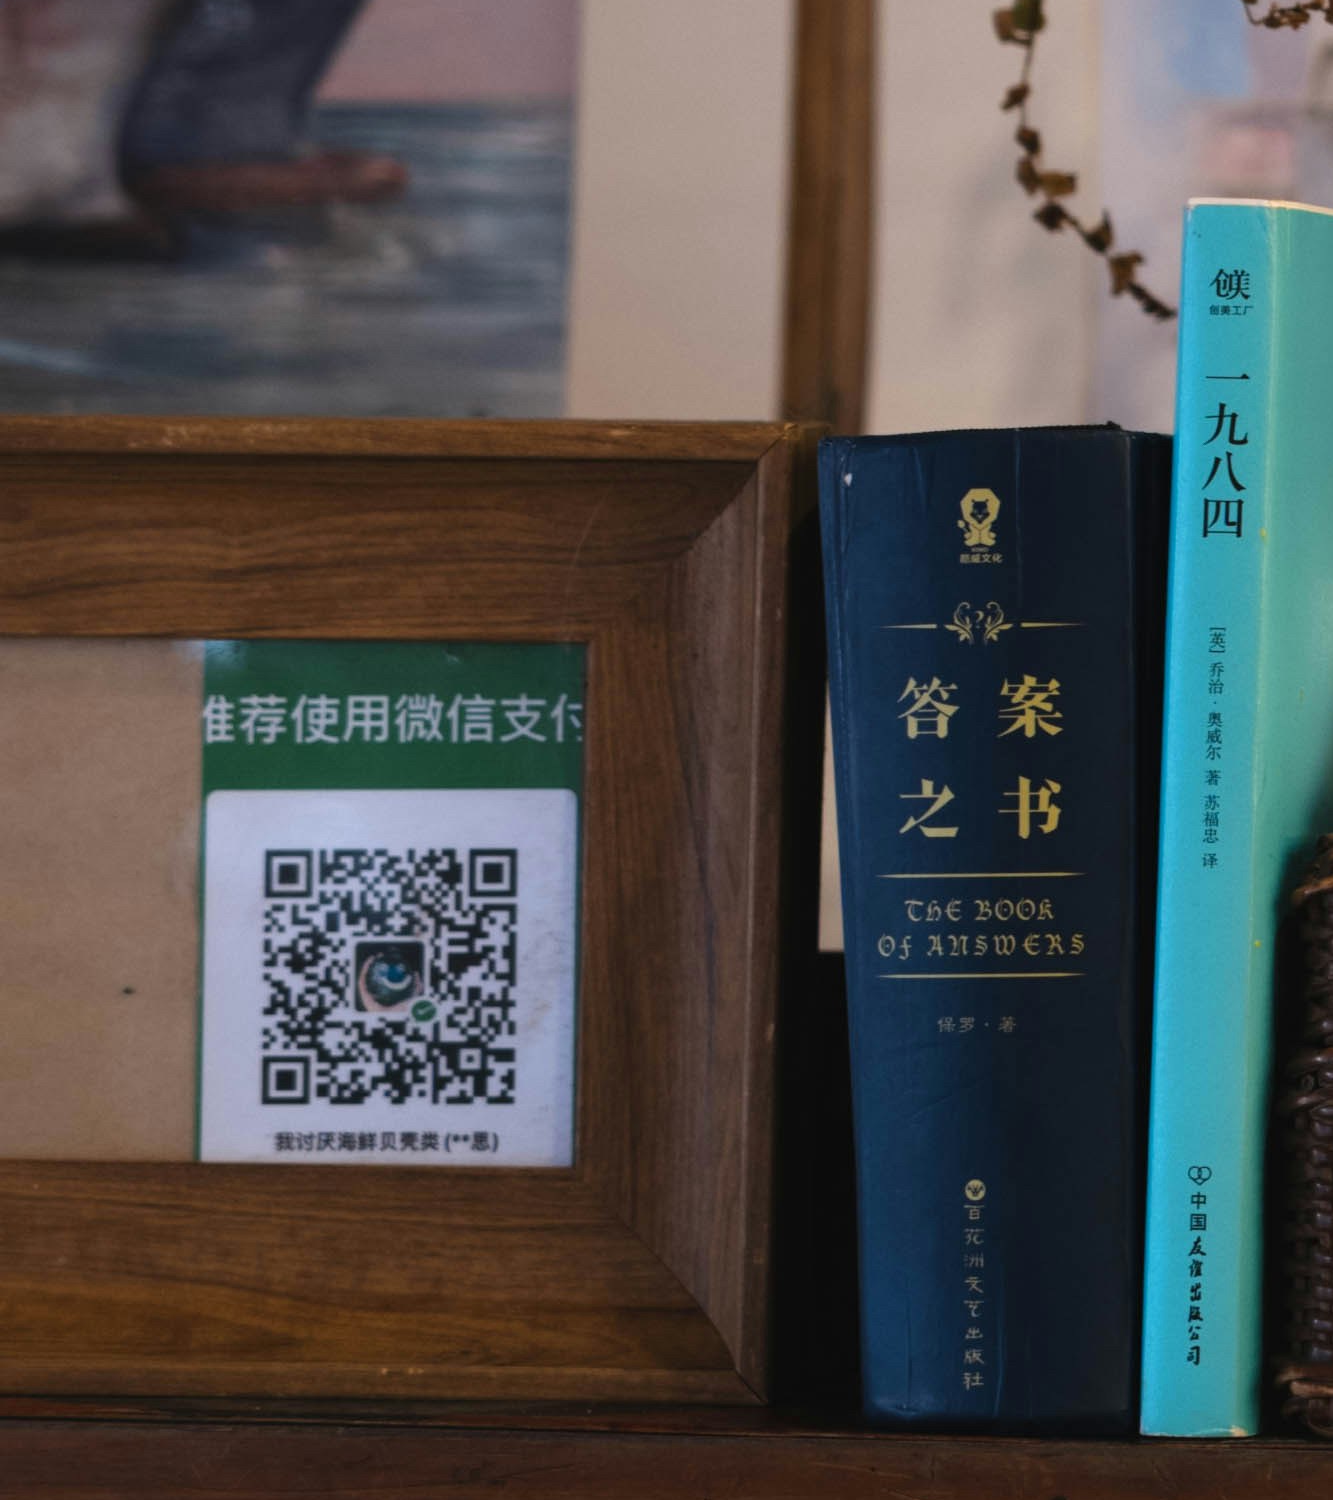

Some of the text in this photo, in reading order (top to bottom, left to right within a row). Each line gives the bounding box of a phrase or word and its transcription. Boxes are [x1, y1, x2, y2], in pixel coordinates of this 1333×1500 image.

[1209, 304, 1254, 316] 创美工厂
[1201, 371, 1250, 539] 一九八四
[202, 693, 583, 744] 推荐使用微信支付
[905, 898, 1055, 923] THE BOOK
[926, 932, 1086, 957] ANSWERS
[962, 1204, 986, 1392] 百花洲文艺出版社
